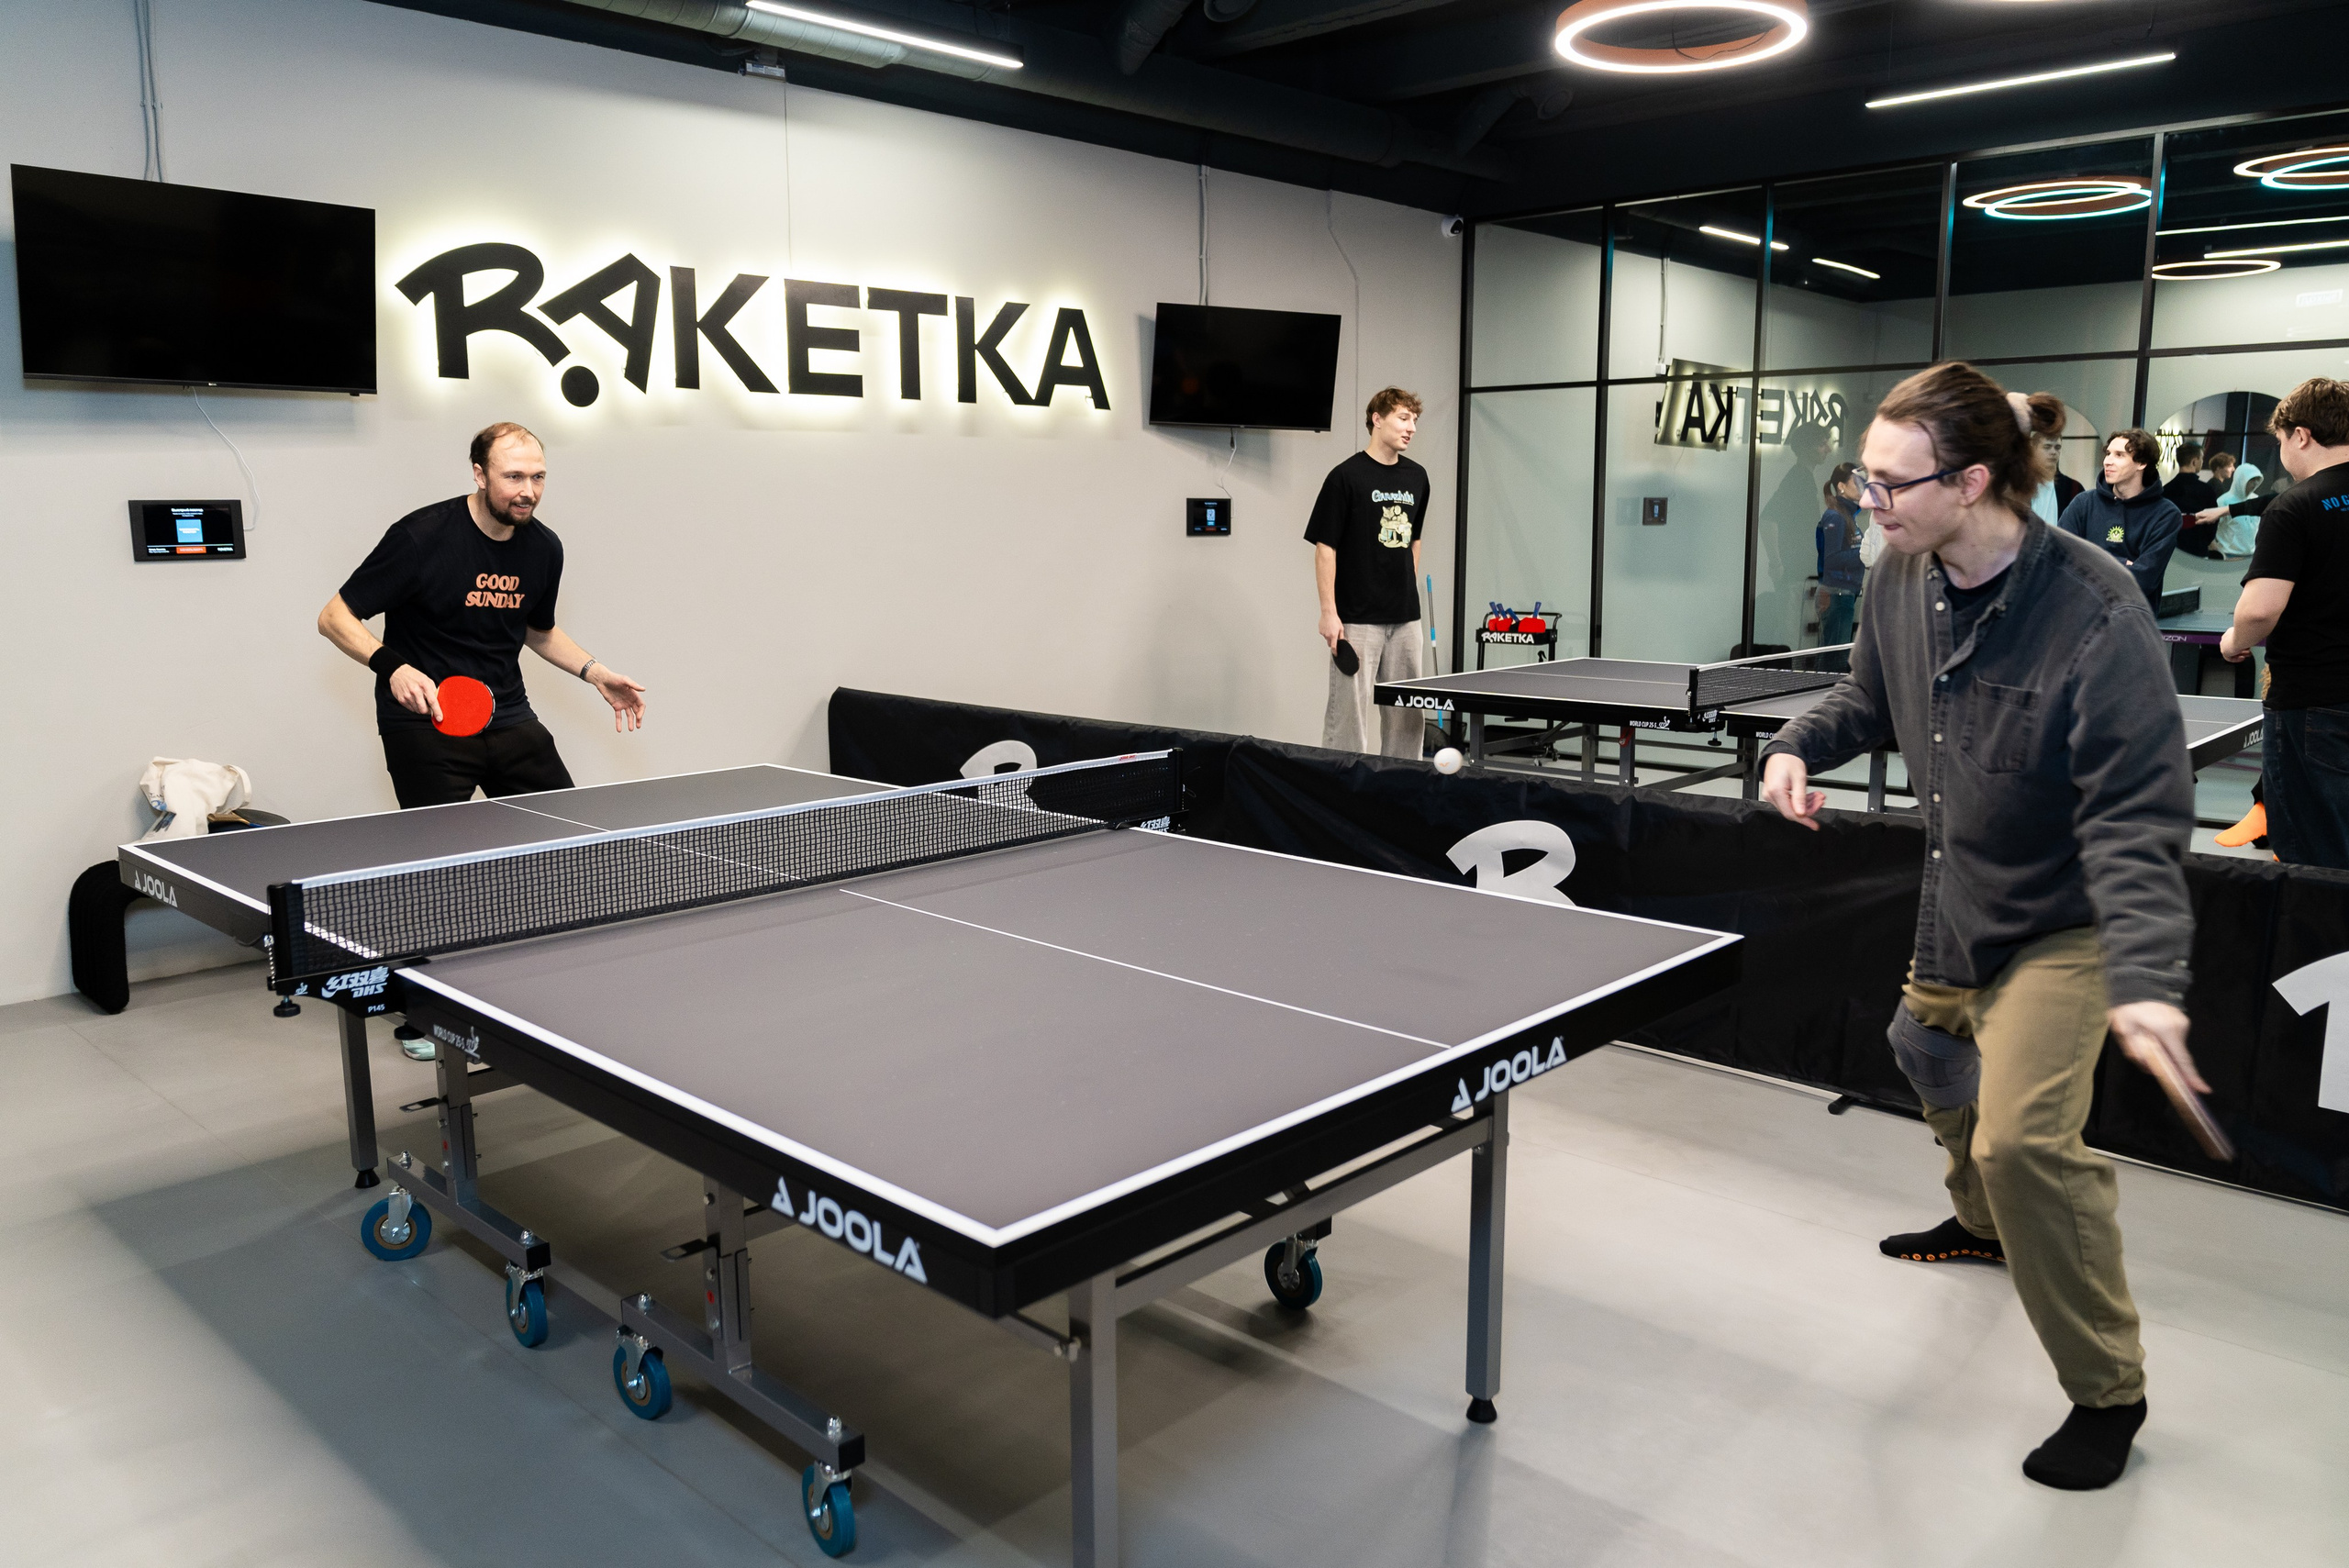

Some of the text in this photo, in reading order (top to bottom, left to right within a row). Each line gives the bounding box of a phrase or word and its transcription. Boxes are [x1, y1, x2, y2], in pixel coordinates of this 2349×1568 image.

[395, 242, 1111, 410] RAKETKA
[2321, 496, 2341, 511] NO
[476, 573, 519, 591] GOOD
[465, 591, 525, 608] SUNDAY
[1481, 632, 1534, 644] RAKETKA
[1406, 695, 1455, 711] JOOLA
[142, 873, 178, 907] JOOLA
[321, 966, 389, 998] 红双喜
[351, 982, 388, 998] DHS
[368, 1004, 385, 1013] P145
[1474, 1036, 1567, 1102] JOOLA
[798, 1189, 929, 1284] JOOLA
